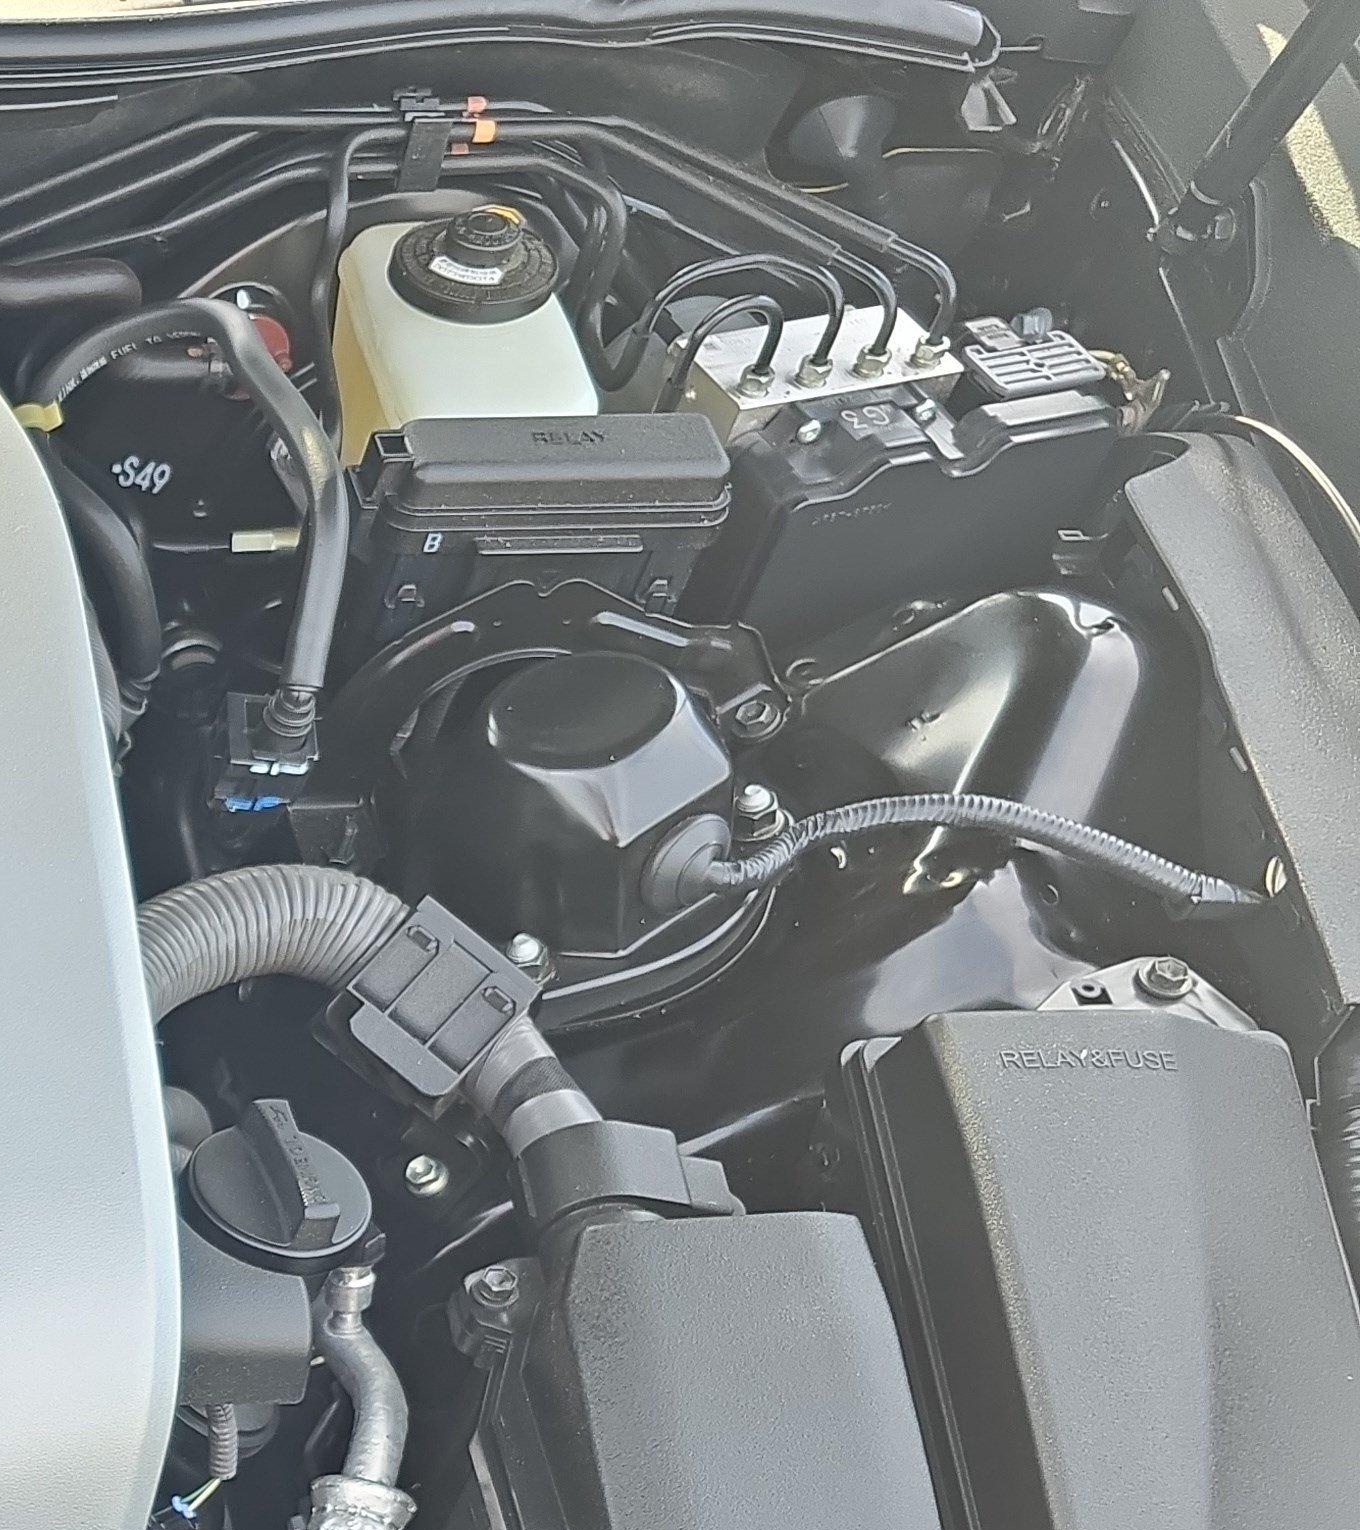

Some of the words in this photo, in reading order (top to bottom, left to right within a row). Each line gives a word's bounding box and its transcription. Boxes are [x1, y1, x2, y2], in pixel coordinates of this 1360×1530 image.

[531, 430, 606, 446] RELAY
[423, 532, 443, 553] B
[999, 1048, 1179, 1072] RELAY&FUSE
